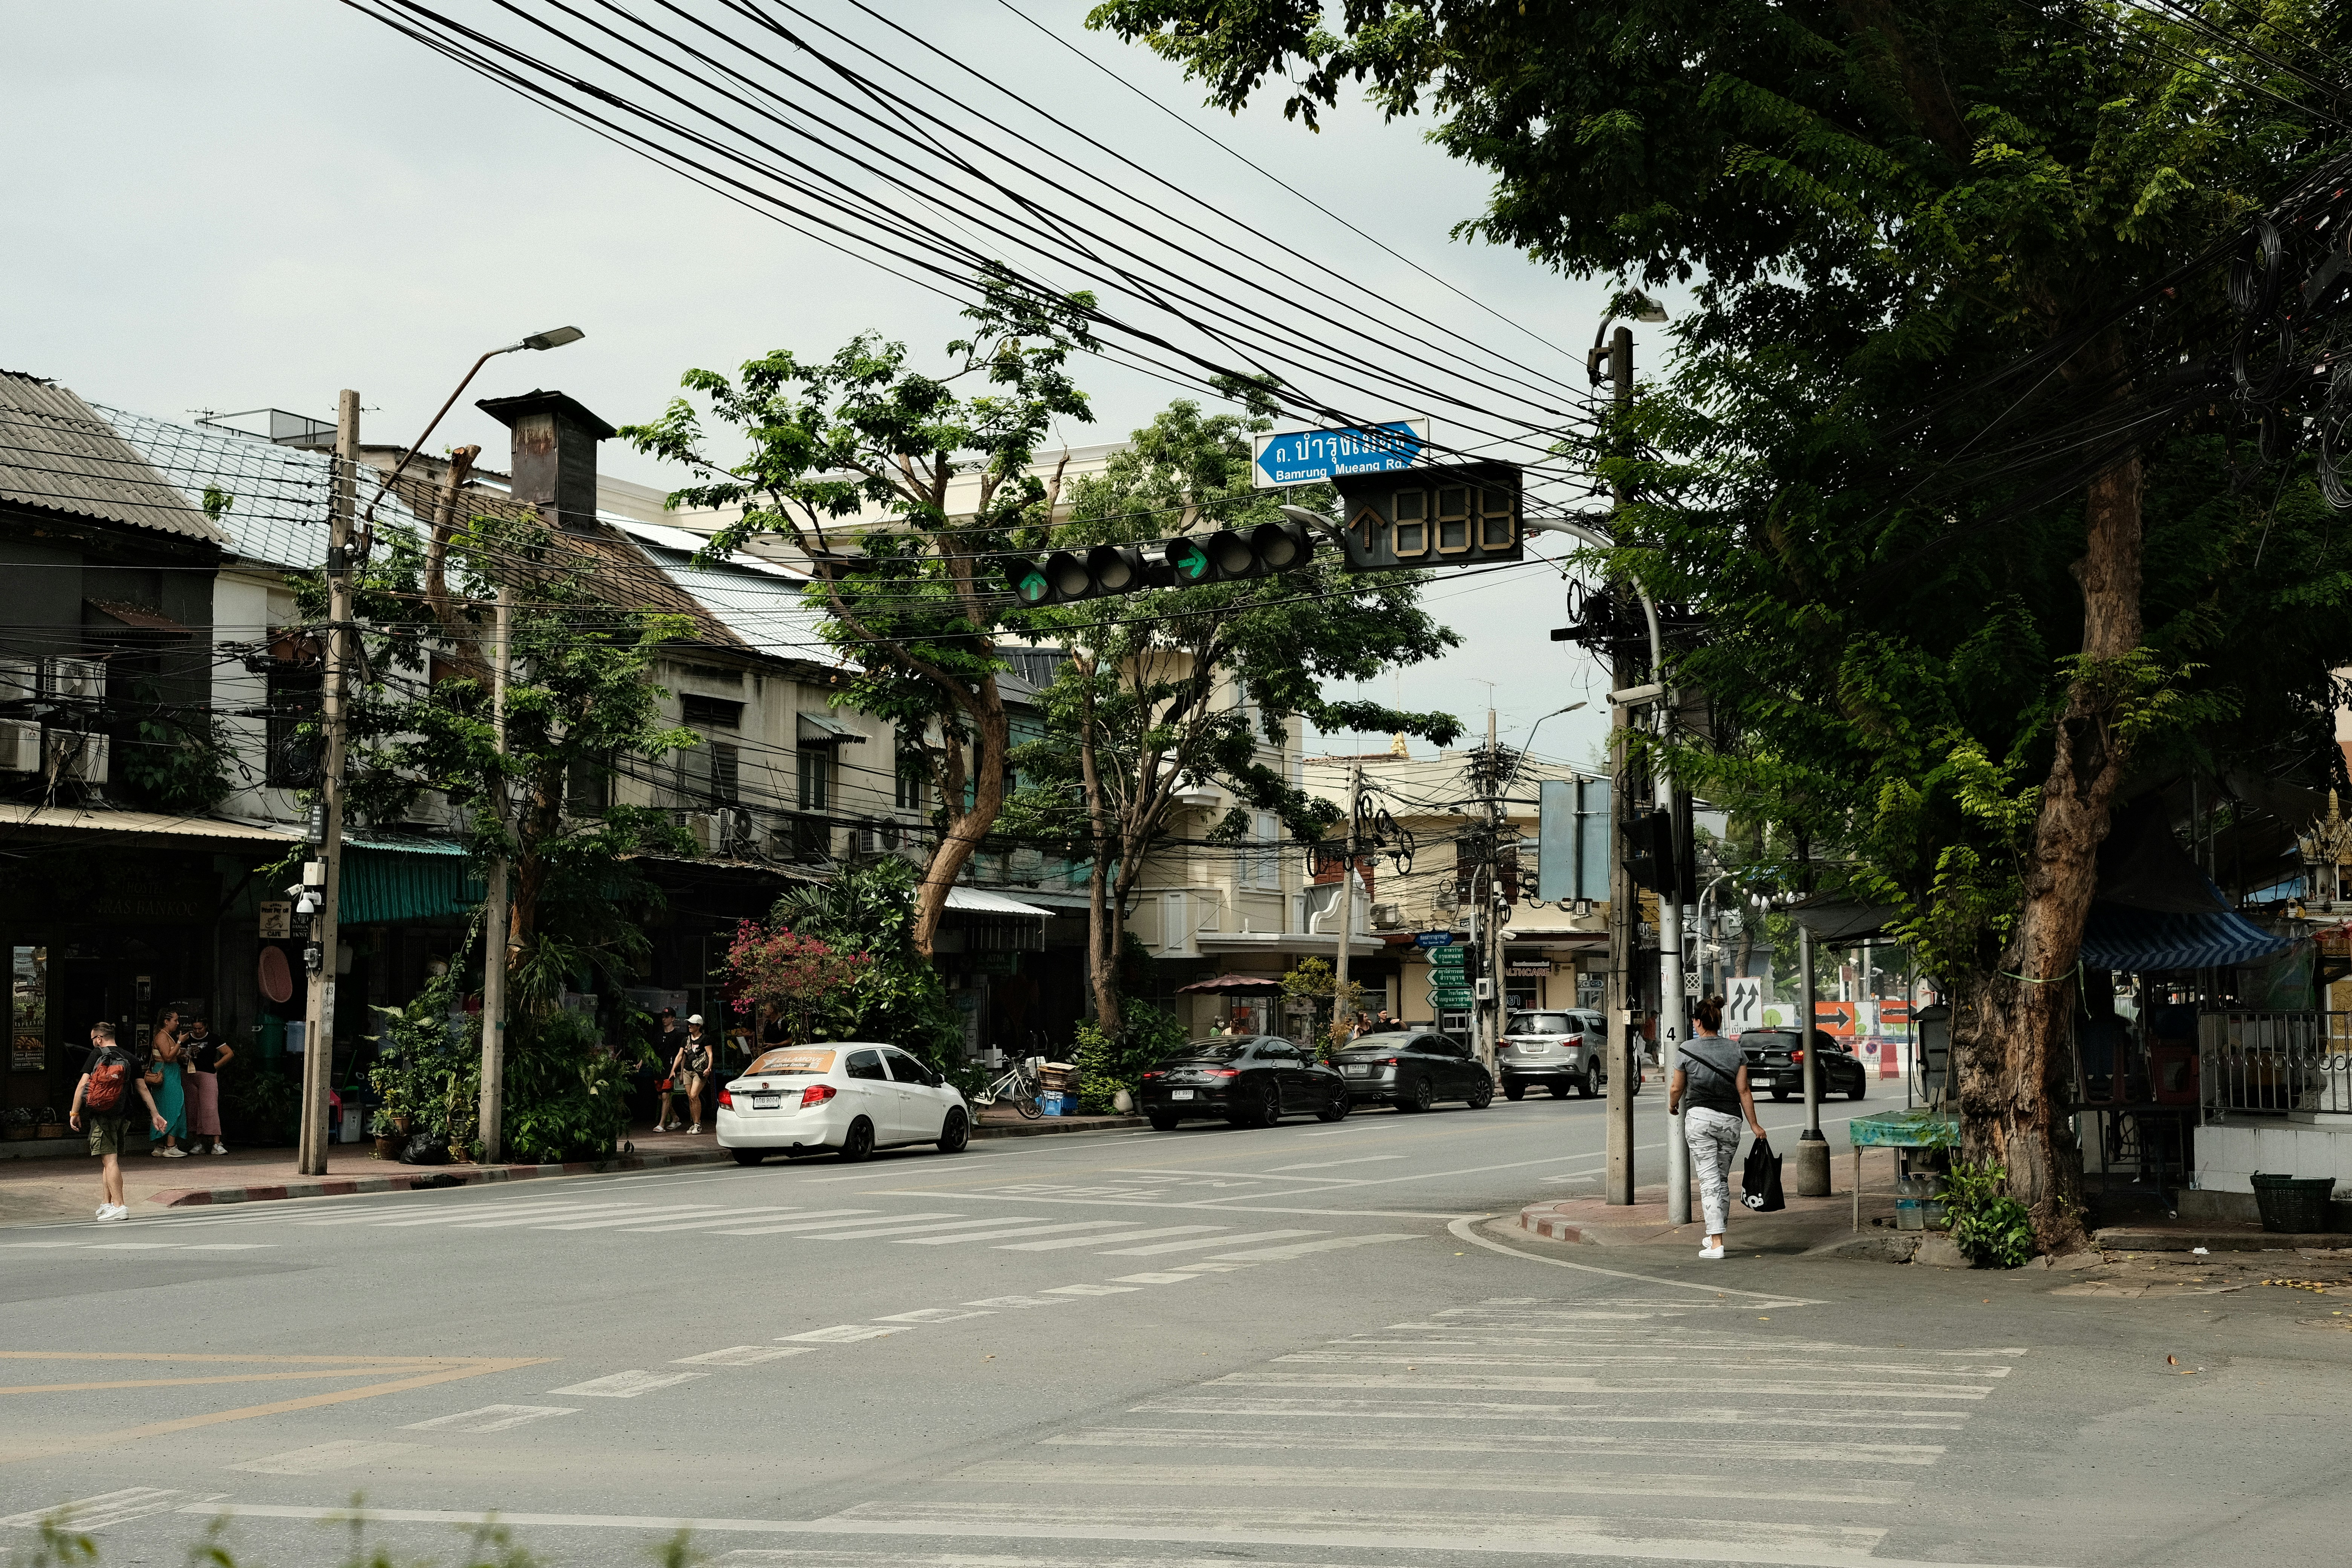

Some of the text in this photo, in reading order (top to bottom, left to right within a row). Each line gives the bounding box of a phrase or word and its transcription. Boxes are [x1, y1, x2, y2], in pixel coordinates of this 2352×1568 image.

[1276, 459, 1406, 481] Bamrung Mueang Rd.
[986, 954, 1005, 963] ATM
[15, 995, 43, 1004] DESSERT
[1666, 1027, 1676, 1041] 4
